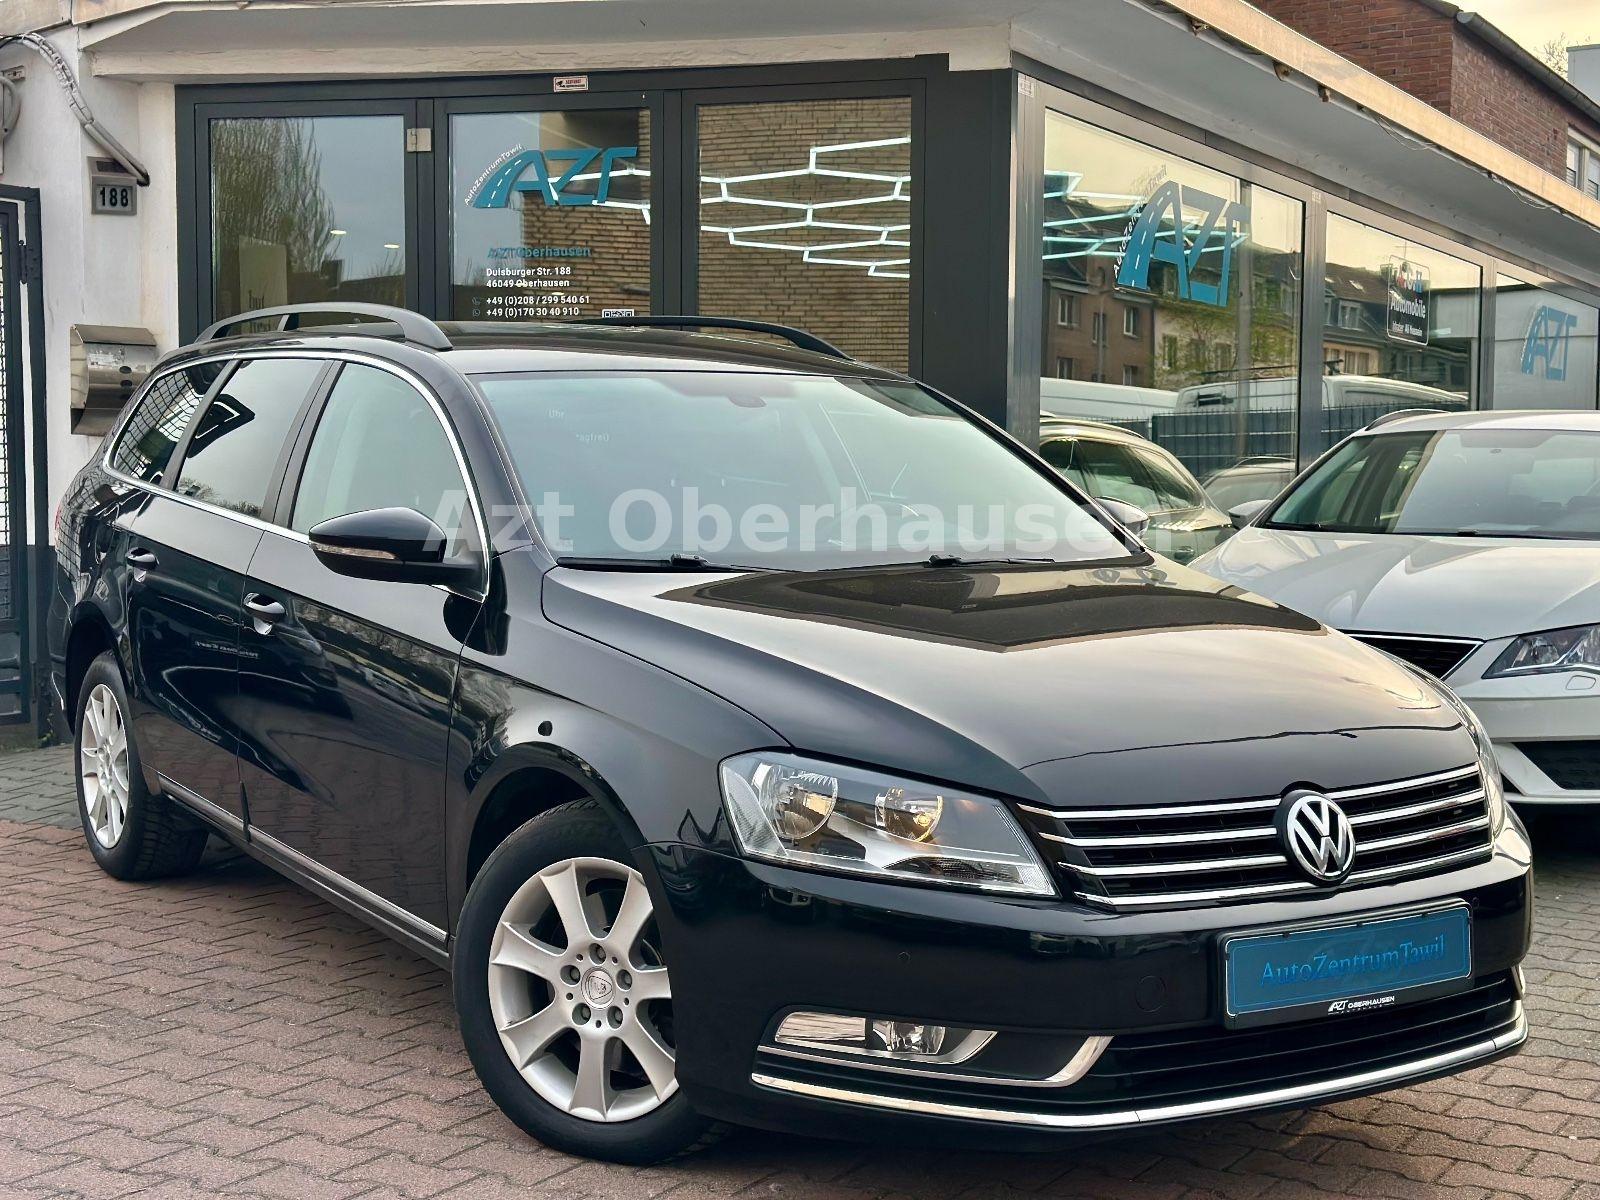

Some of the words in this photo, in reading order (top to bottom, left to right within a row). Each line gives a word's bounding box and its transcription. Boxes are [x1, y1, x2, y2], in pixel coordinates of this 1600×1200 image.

[100, 187, 129, 207] 188
[517, 246, 591, 258] Oberhausen
[486, 267, 535, 277] Duisburger
[536, 267, 553, 276] Str.
[554, 267, 571, 275] 188
[486, 279, 514, 288] 46049
[516, 279, 570, 288] Oberhausen
[486, 296, 503, 305] +49
[504, 296, 535, 306] (0)208
[541, 296, 559, 304] 299
[560, 296, 577, 304] 540
[486, 308, 503, 317] +49
[504, 308, 535, 318] (0)170
[536, 308, 548, 316] 30
[549, 308, 561, 316] 40
[562, 307, 580, 315] 910
[1391, 297, 1426, 319] Automobile
[1348, 996, 1395, 1009] OBERHAUSEN
